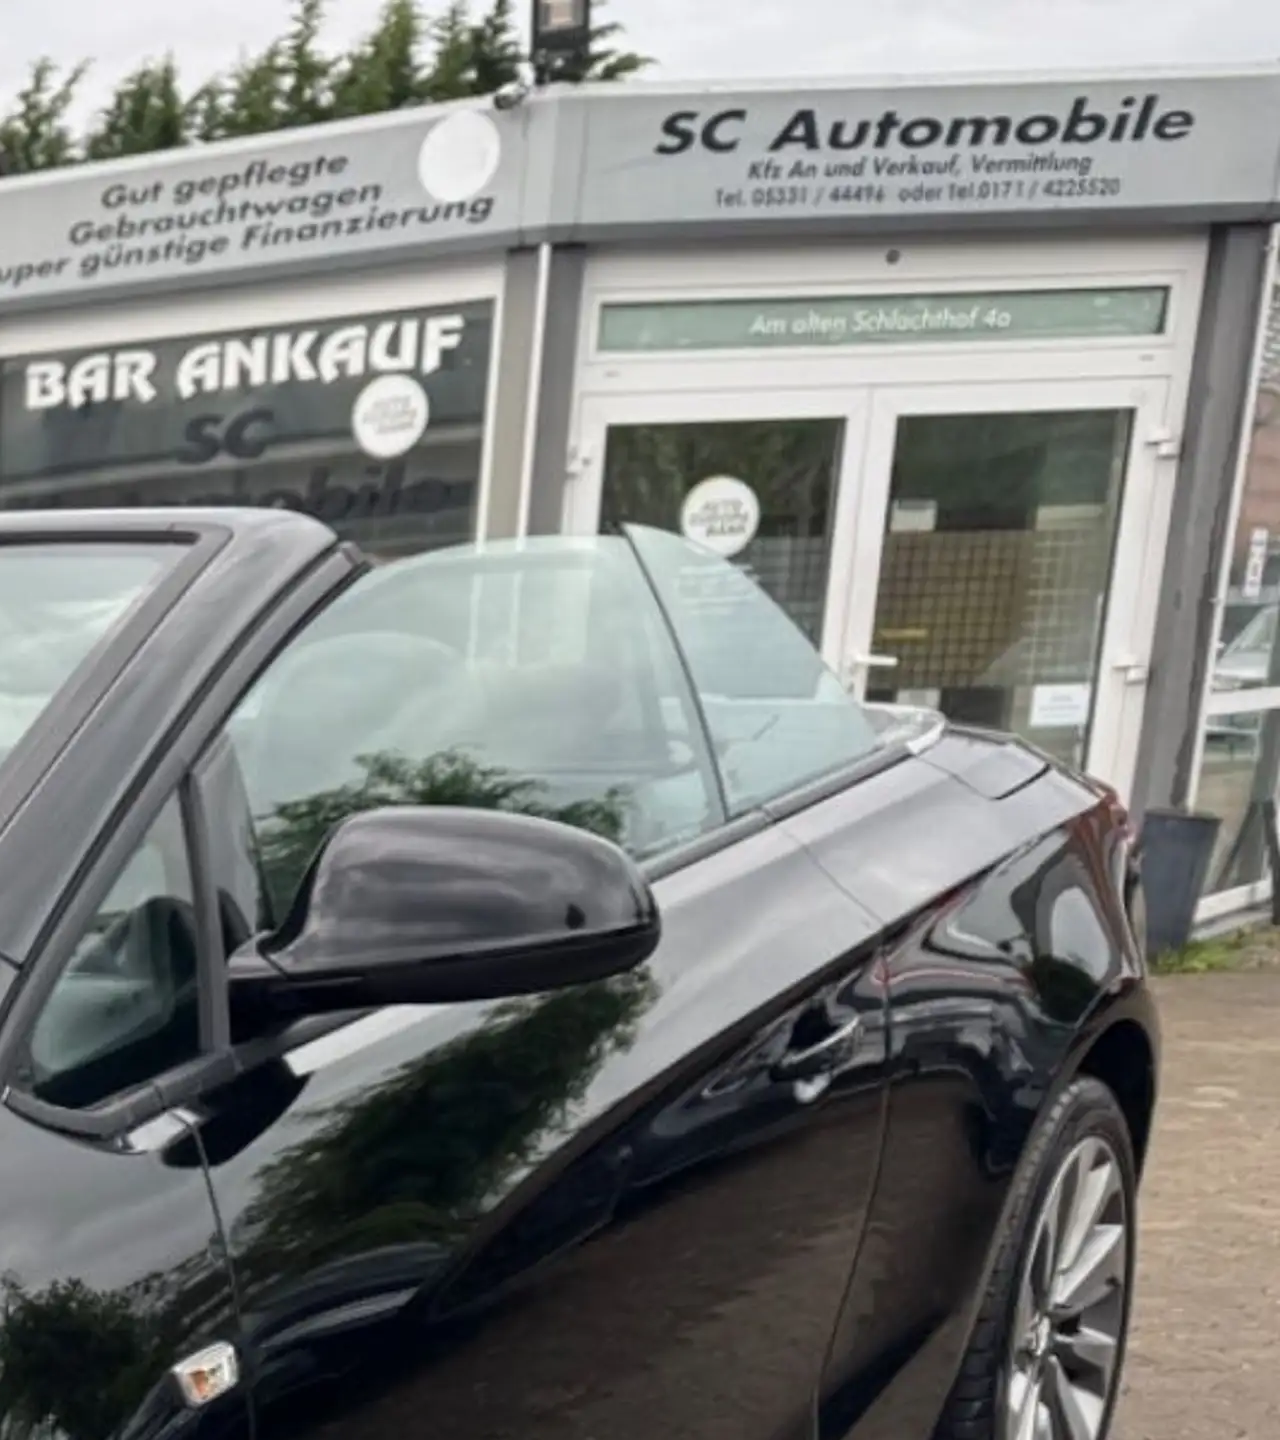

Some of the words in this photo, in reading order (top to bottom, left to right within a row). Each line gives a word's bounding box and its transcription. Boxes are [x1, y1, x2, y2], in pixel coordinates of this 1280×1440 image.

[653, 108, 748, 155] SC
[766, 93, 1195, 151] Automobile
[100, 181, 164, 210] Gut
[172, 154, 349, 205] gepflegte
[747, 158, 782, 180] Kfz
[787, 160, 818, 179] An
[824, 156, 867, 178] und
[971, 151, 1094, 176] Vermittlung
[898, 180, 942, 202] oder
[68, 184, 383, 246] Gebrauchtwagen
[78, 234, 230, 278] günstige
[240, 197, 495, 250] Finanzierung
[749, 314, 787, 336] Am
[852, 305, 980, 333] Schlachthof
[24, 349, 157, 410] BAR
[175, 314, 465, 400] ANKAUF
[175, 408, 275, 465] SC
